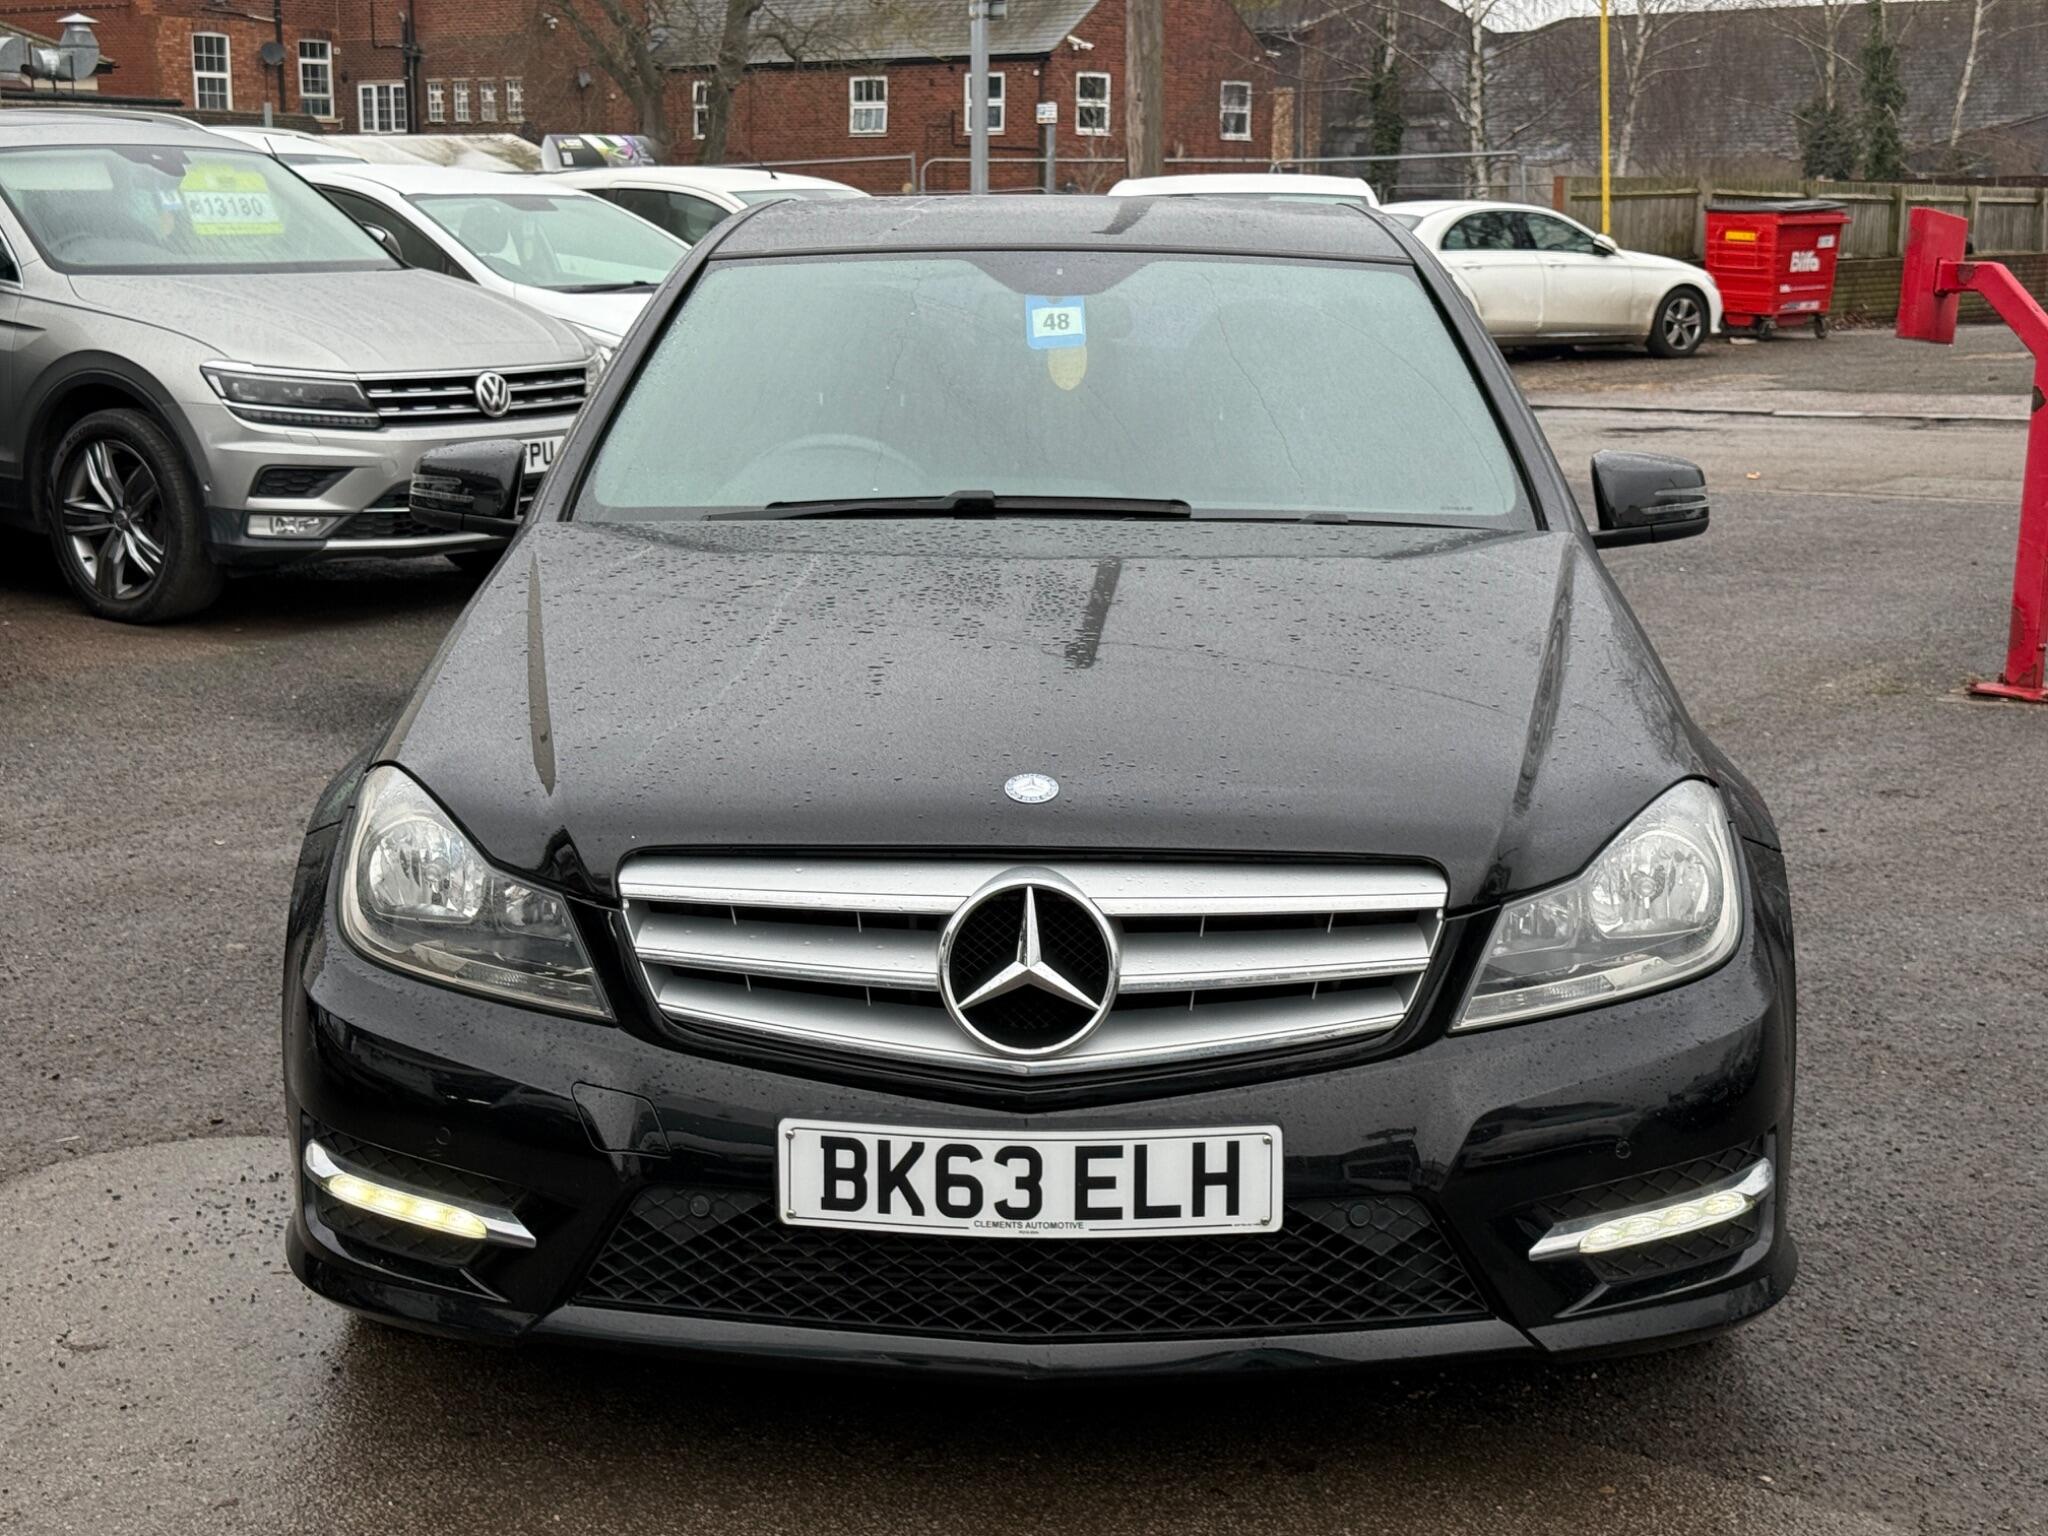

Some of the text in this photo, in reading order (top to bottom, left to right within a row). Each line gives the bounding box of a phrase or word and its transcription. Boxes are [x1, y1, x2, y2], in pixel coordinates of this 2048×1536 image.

[1043, 313, 1070, 330] 48
[821, 1136, 1240, 1221] BK63 ELH
[974, 1220, 1084, 1230] CLEMENTS AUTOMOTIVE
